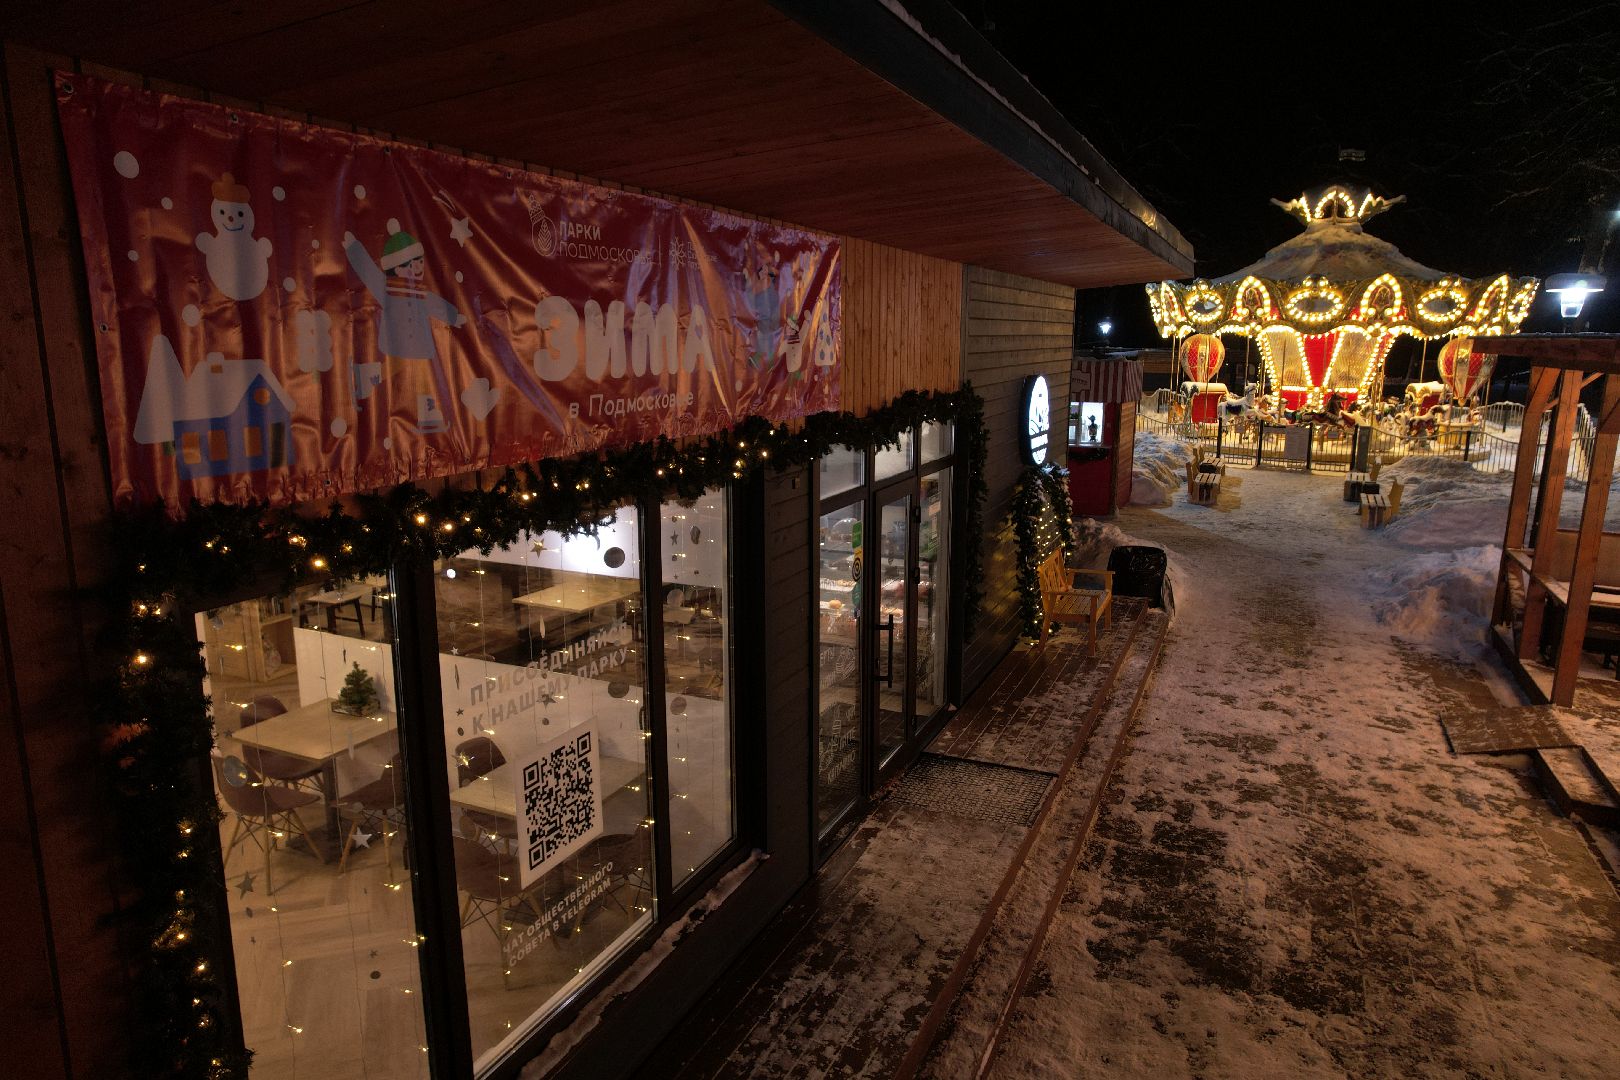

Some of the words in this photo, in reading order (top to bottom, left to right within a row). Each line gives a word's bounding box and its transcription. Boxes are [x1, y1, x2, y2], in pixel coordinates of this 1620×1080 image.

[560, 220, 601, 240] ПАРКИ
[534, 295, 714, 382] ЗИМА
[569, 403, 580, 419] в
[588, 391, 694, 418] Подмоскове
[472, 713, 485, 735] К
[577, 646, 628, 682] ПАРКУ
[503, 932, 525, 953] ЧАТ
[526, 861, 613, 937] ОБЩЕСТВЕННОГО
[509, 928, 551, 967] СОВЕТА
[552, 921, 560, 931] В
[561, 877, 611, 924] TELEGRAM
